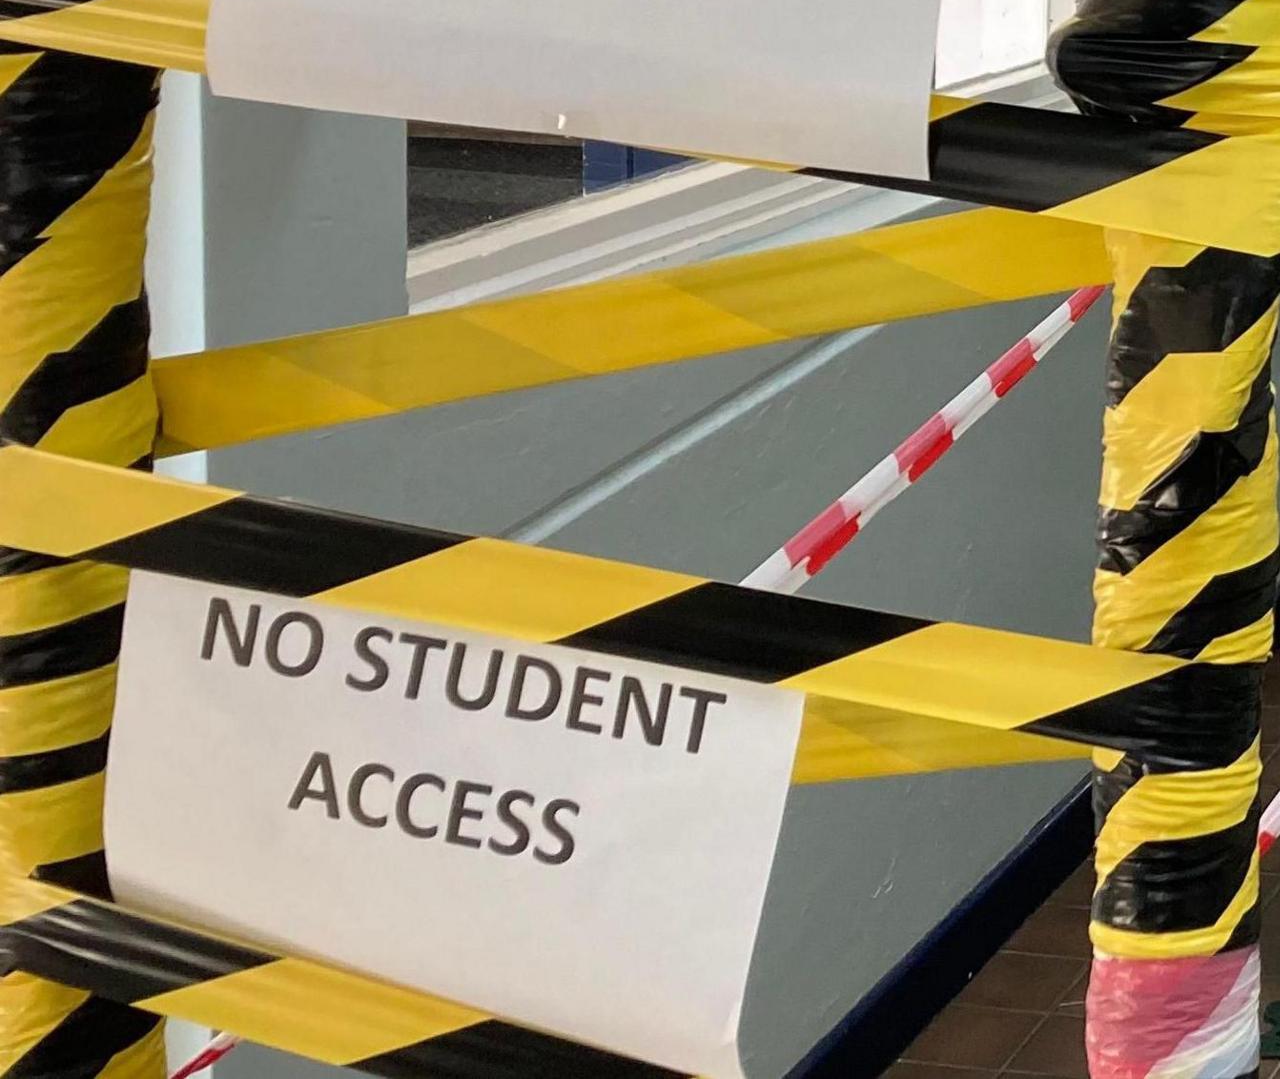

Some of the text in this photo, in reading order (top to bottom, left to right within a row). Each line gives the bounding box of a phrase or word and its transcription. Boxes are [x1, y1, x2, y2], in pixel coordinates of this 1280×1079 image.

[201, 597, 728, 755] NO STUDENT
[287, 751, 581, 866] ACCESS
